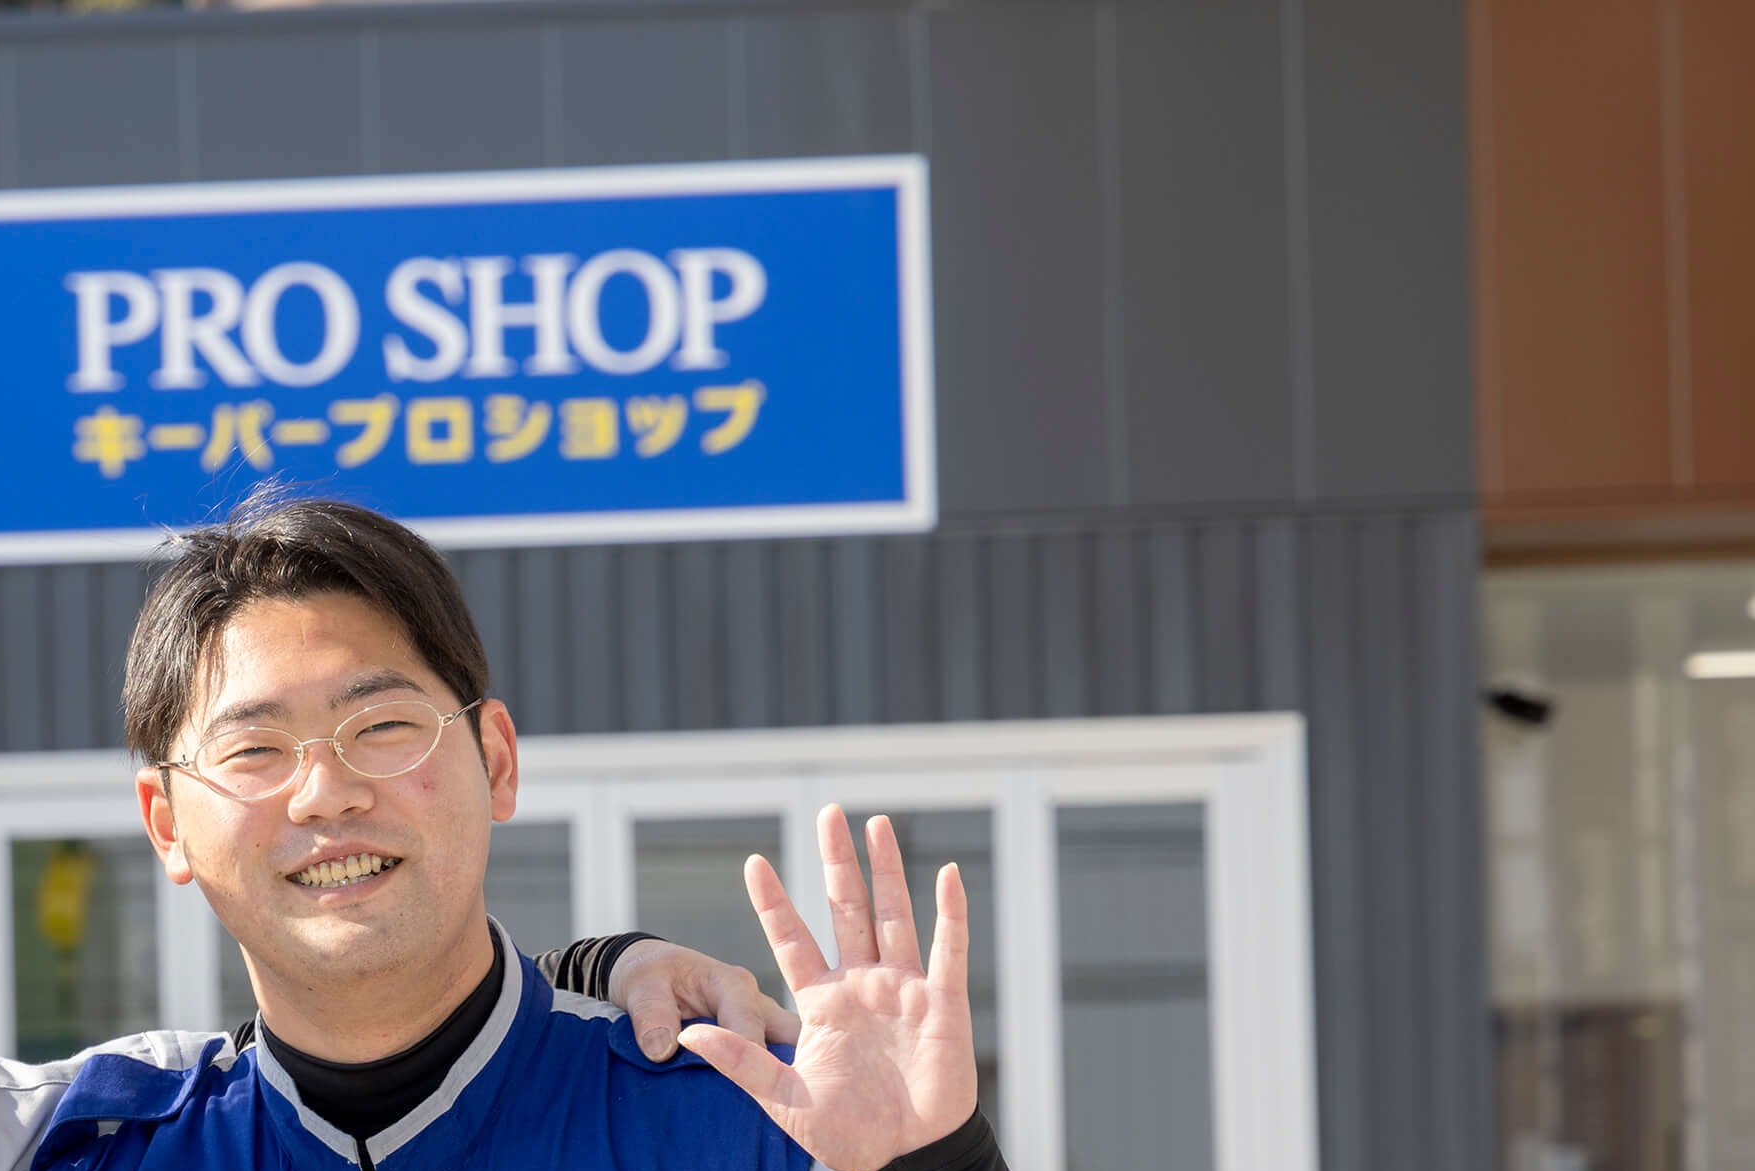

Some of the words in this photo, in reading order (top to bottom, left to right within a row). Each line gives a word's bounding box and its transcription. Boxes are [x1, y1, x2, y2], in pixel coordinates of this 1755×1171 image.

[67, 260, 362, 393] PRO
[382, 247, 767, 383] SHOP
[72, 380, 765, 480] キーパープロショップ
